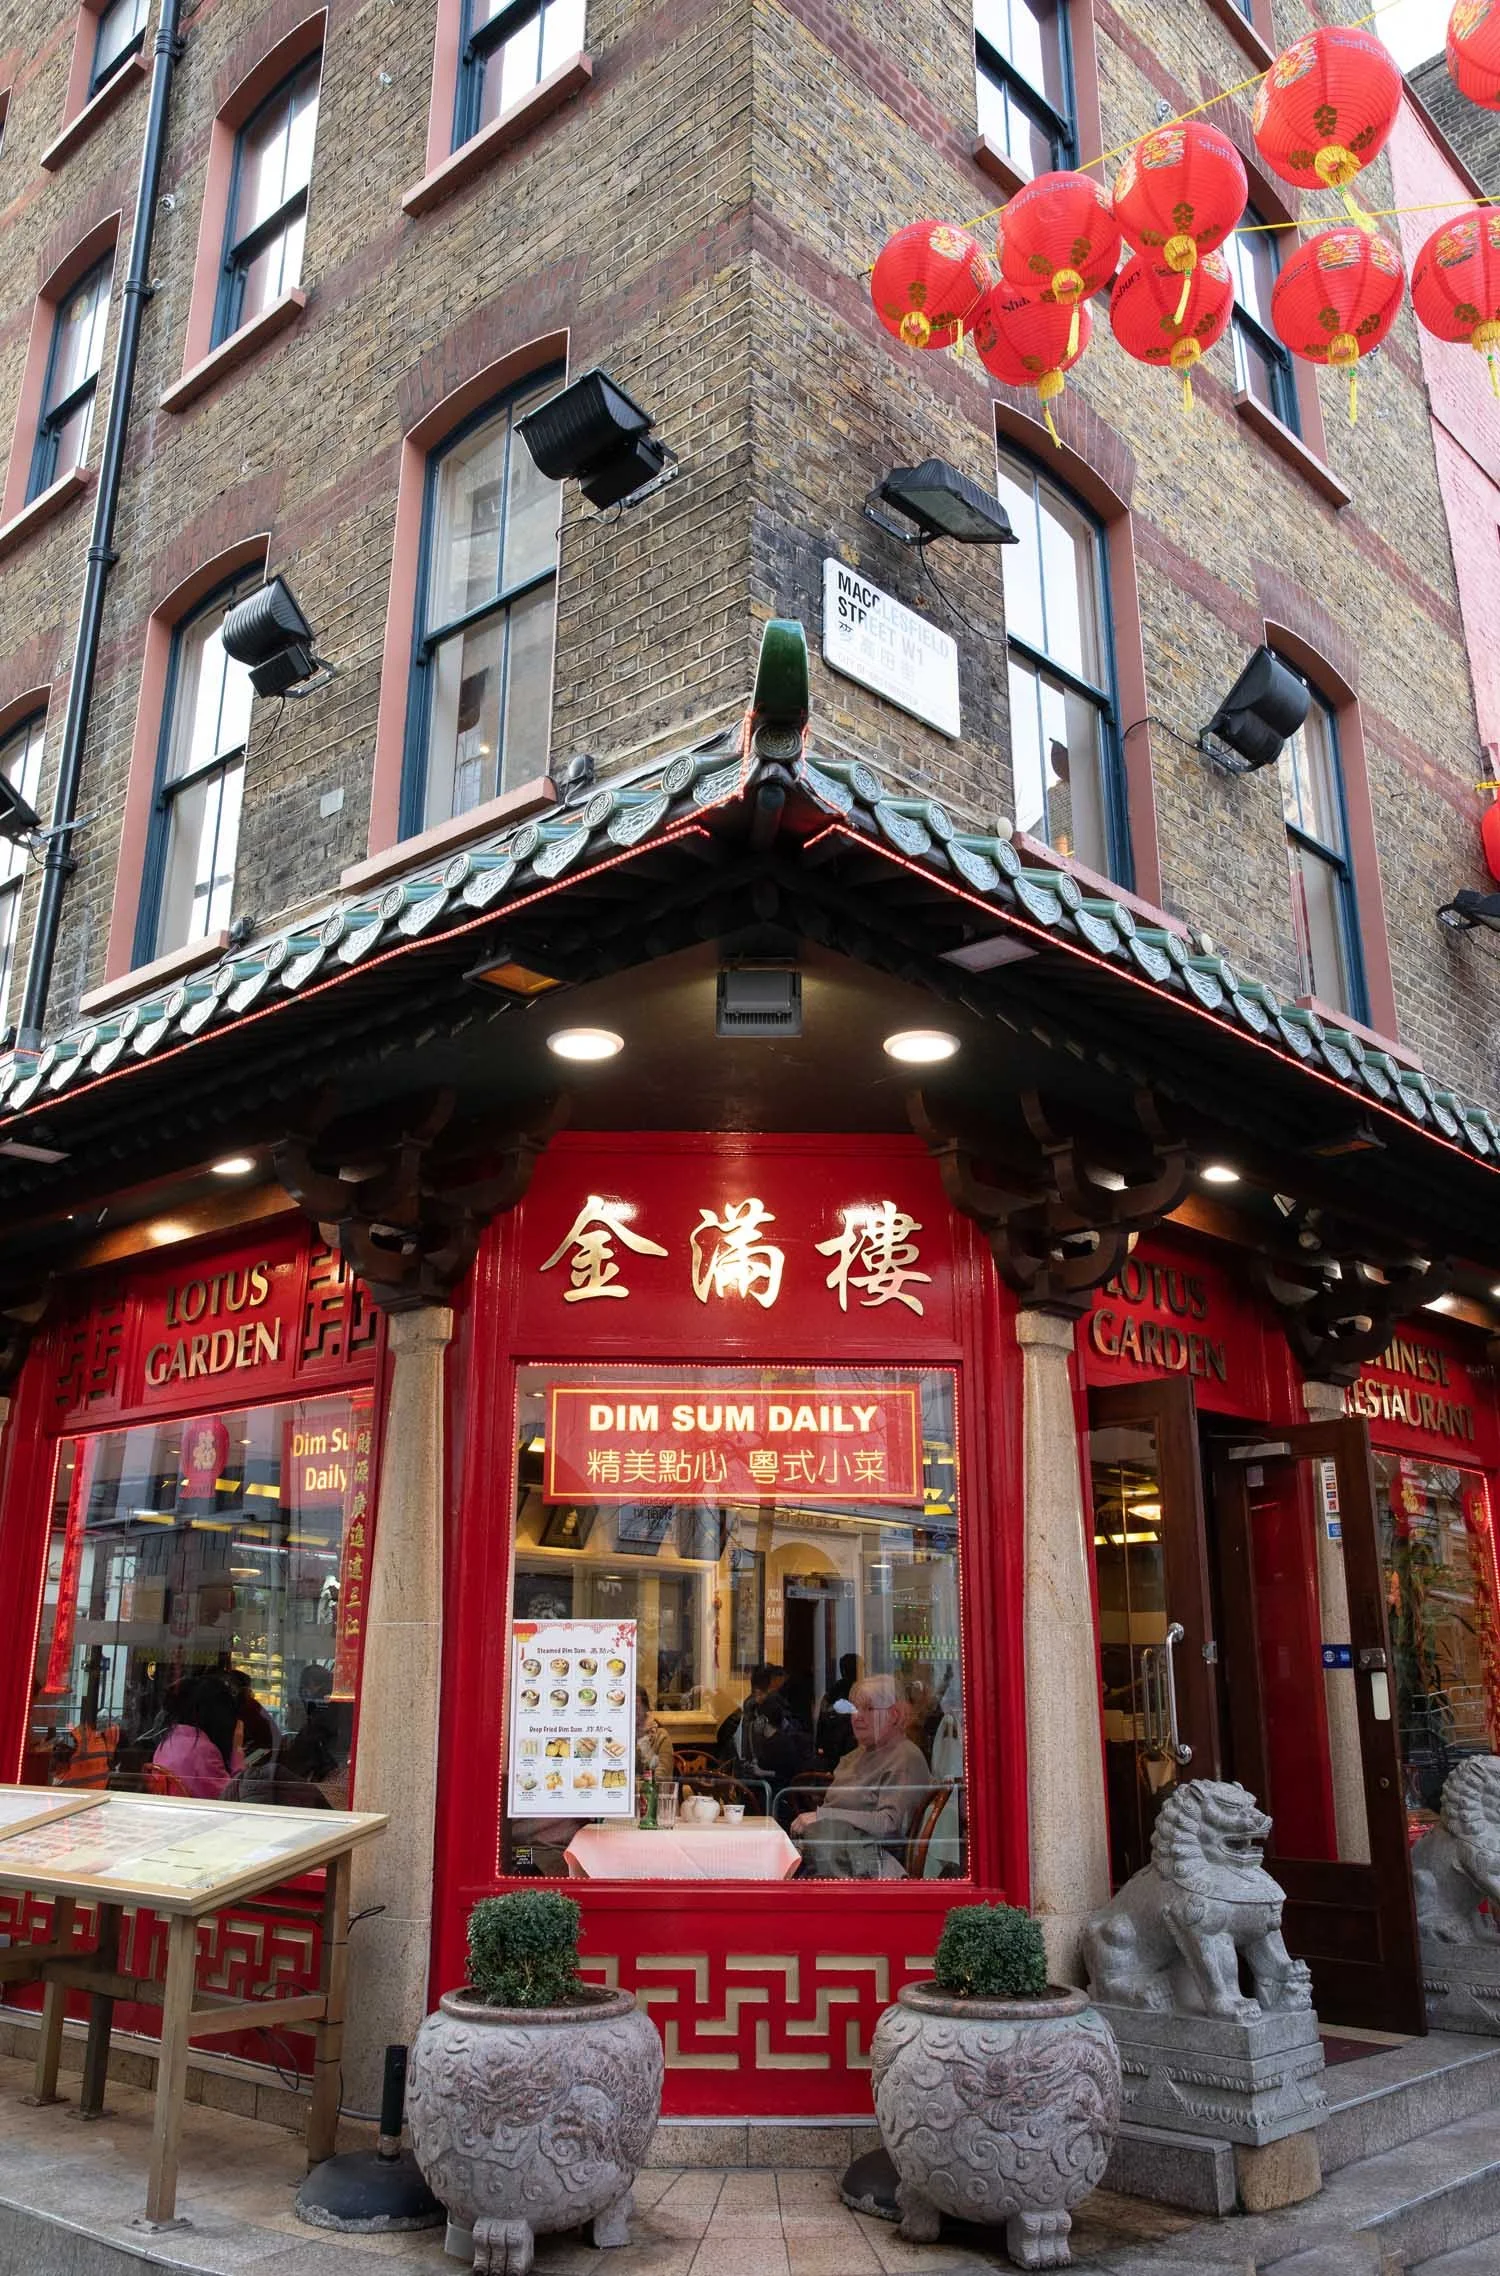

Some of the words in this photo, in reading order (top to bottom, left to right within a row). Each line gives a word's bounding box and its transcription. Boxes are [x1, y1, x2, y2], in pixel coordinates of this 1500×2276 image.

[164, 1260, 269, 1326] LOTUS
[145, 1317, 281, 1385] GARDEN
[1092, 1308, 1226, 1380] GARDEN
[589, 1405, 658, 1432] DIM
[671, 1404, 755, 1432] SUM
[768, 1405, 878, 1432] DAILY
[293, 1432, 327, 1457] Dim
[331, 1427, 350, 1453] Su
[305, 1464, 347, 1492] Daily
[587, 1449, 727, 1484] 精美點心
[747, 1449, 888, 1484] 粵式小菜
